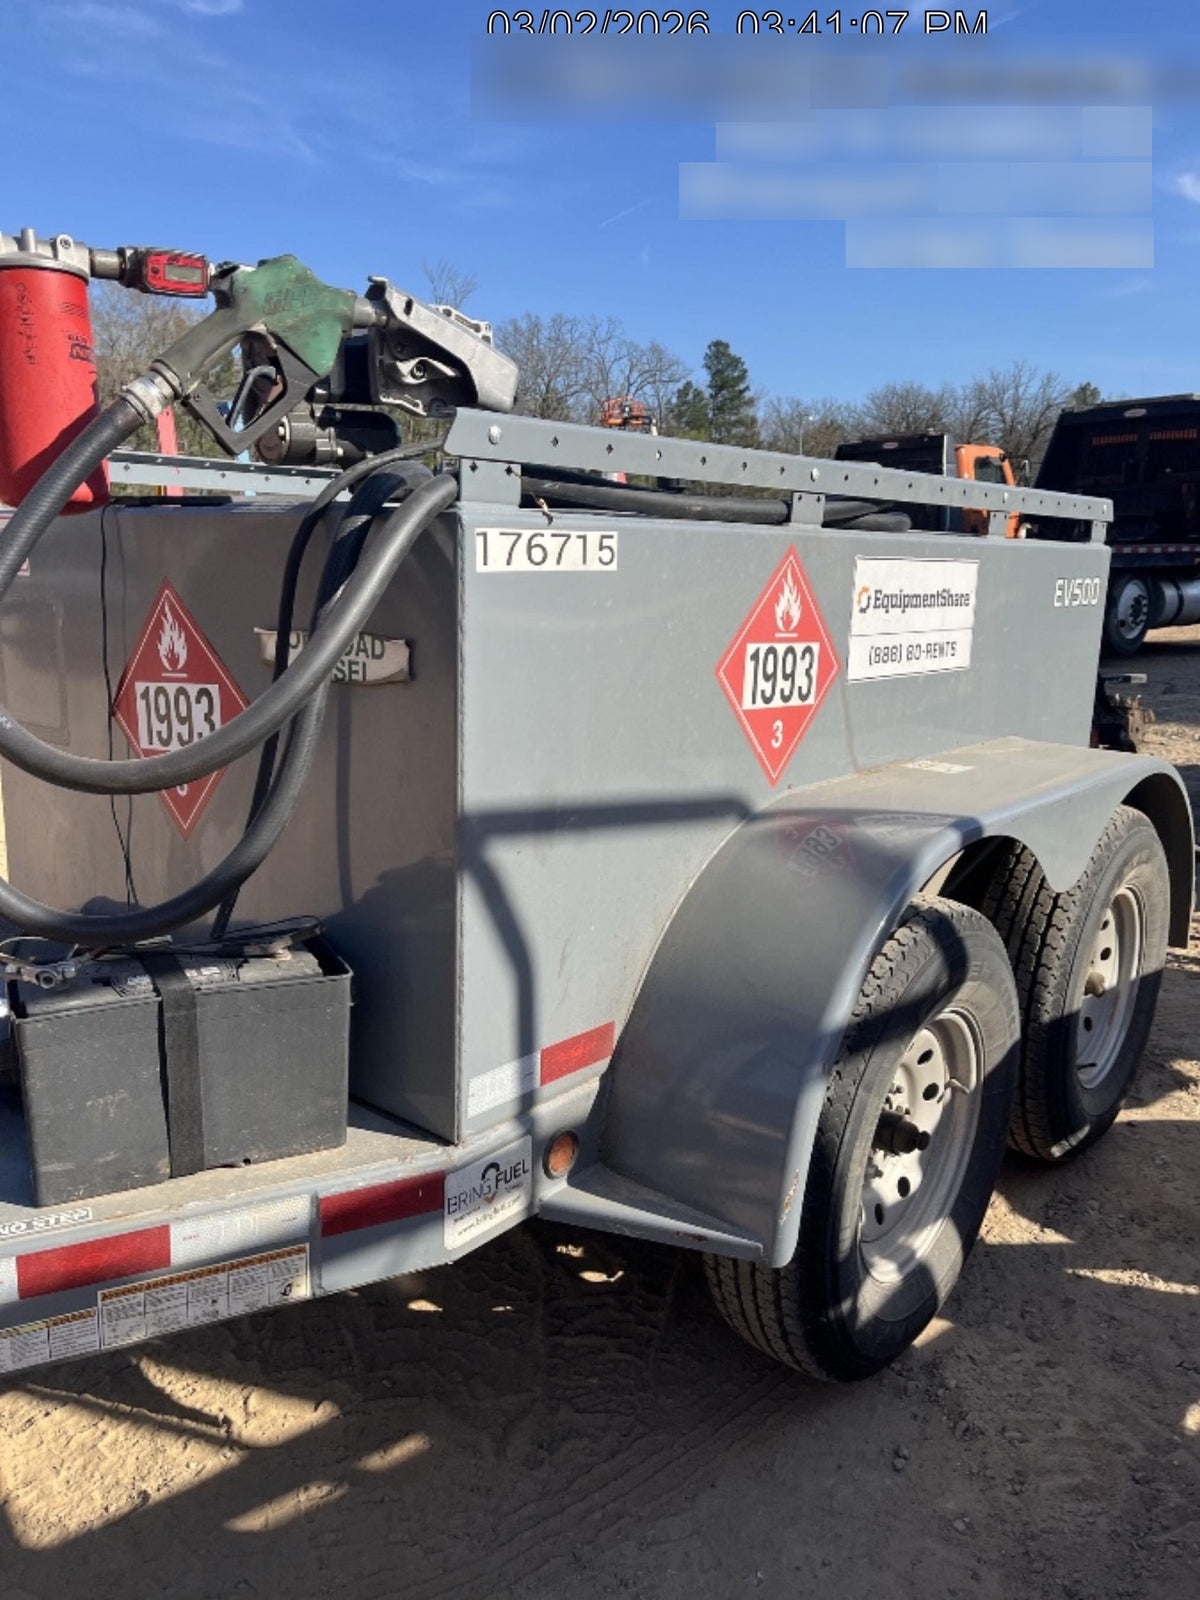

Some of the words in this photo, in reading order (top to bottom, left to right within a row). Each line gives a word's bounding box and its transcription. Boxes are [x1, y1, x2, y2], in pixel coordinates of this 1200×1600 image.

[475, 531, 616, 566] 176715
[872, 588, 971, 613] EquipmentShare
[1053, 578, 1100, 607] EV500
[868, 643, 903, 666] (888)
[749, 644, 815, 705] 1993
[140, 686, 216, 747] 1993
[771, 719, 784, 748] 3
[447, 1178, 492, 1215] BRING
[495, 1159, 529, 1190] FUEL
